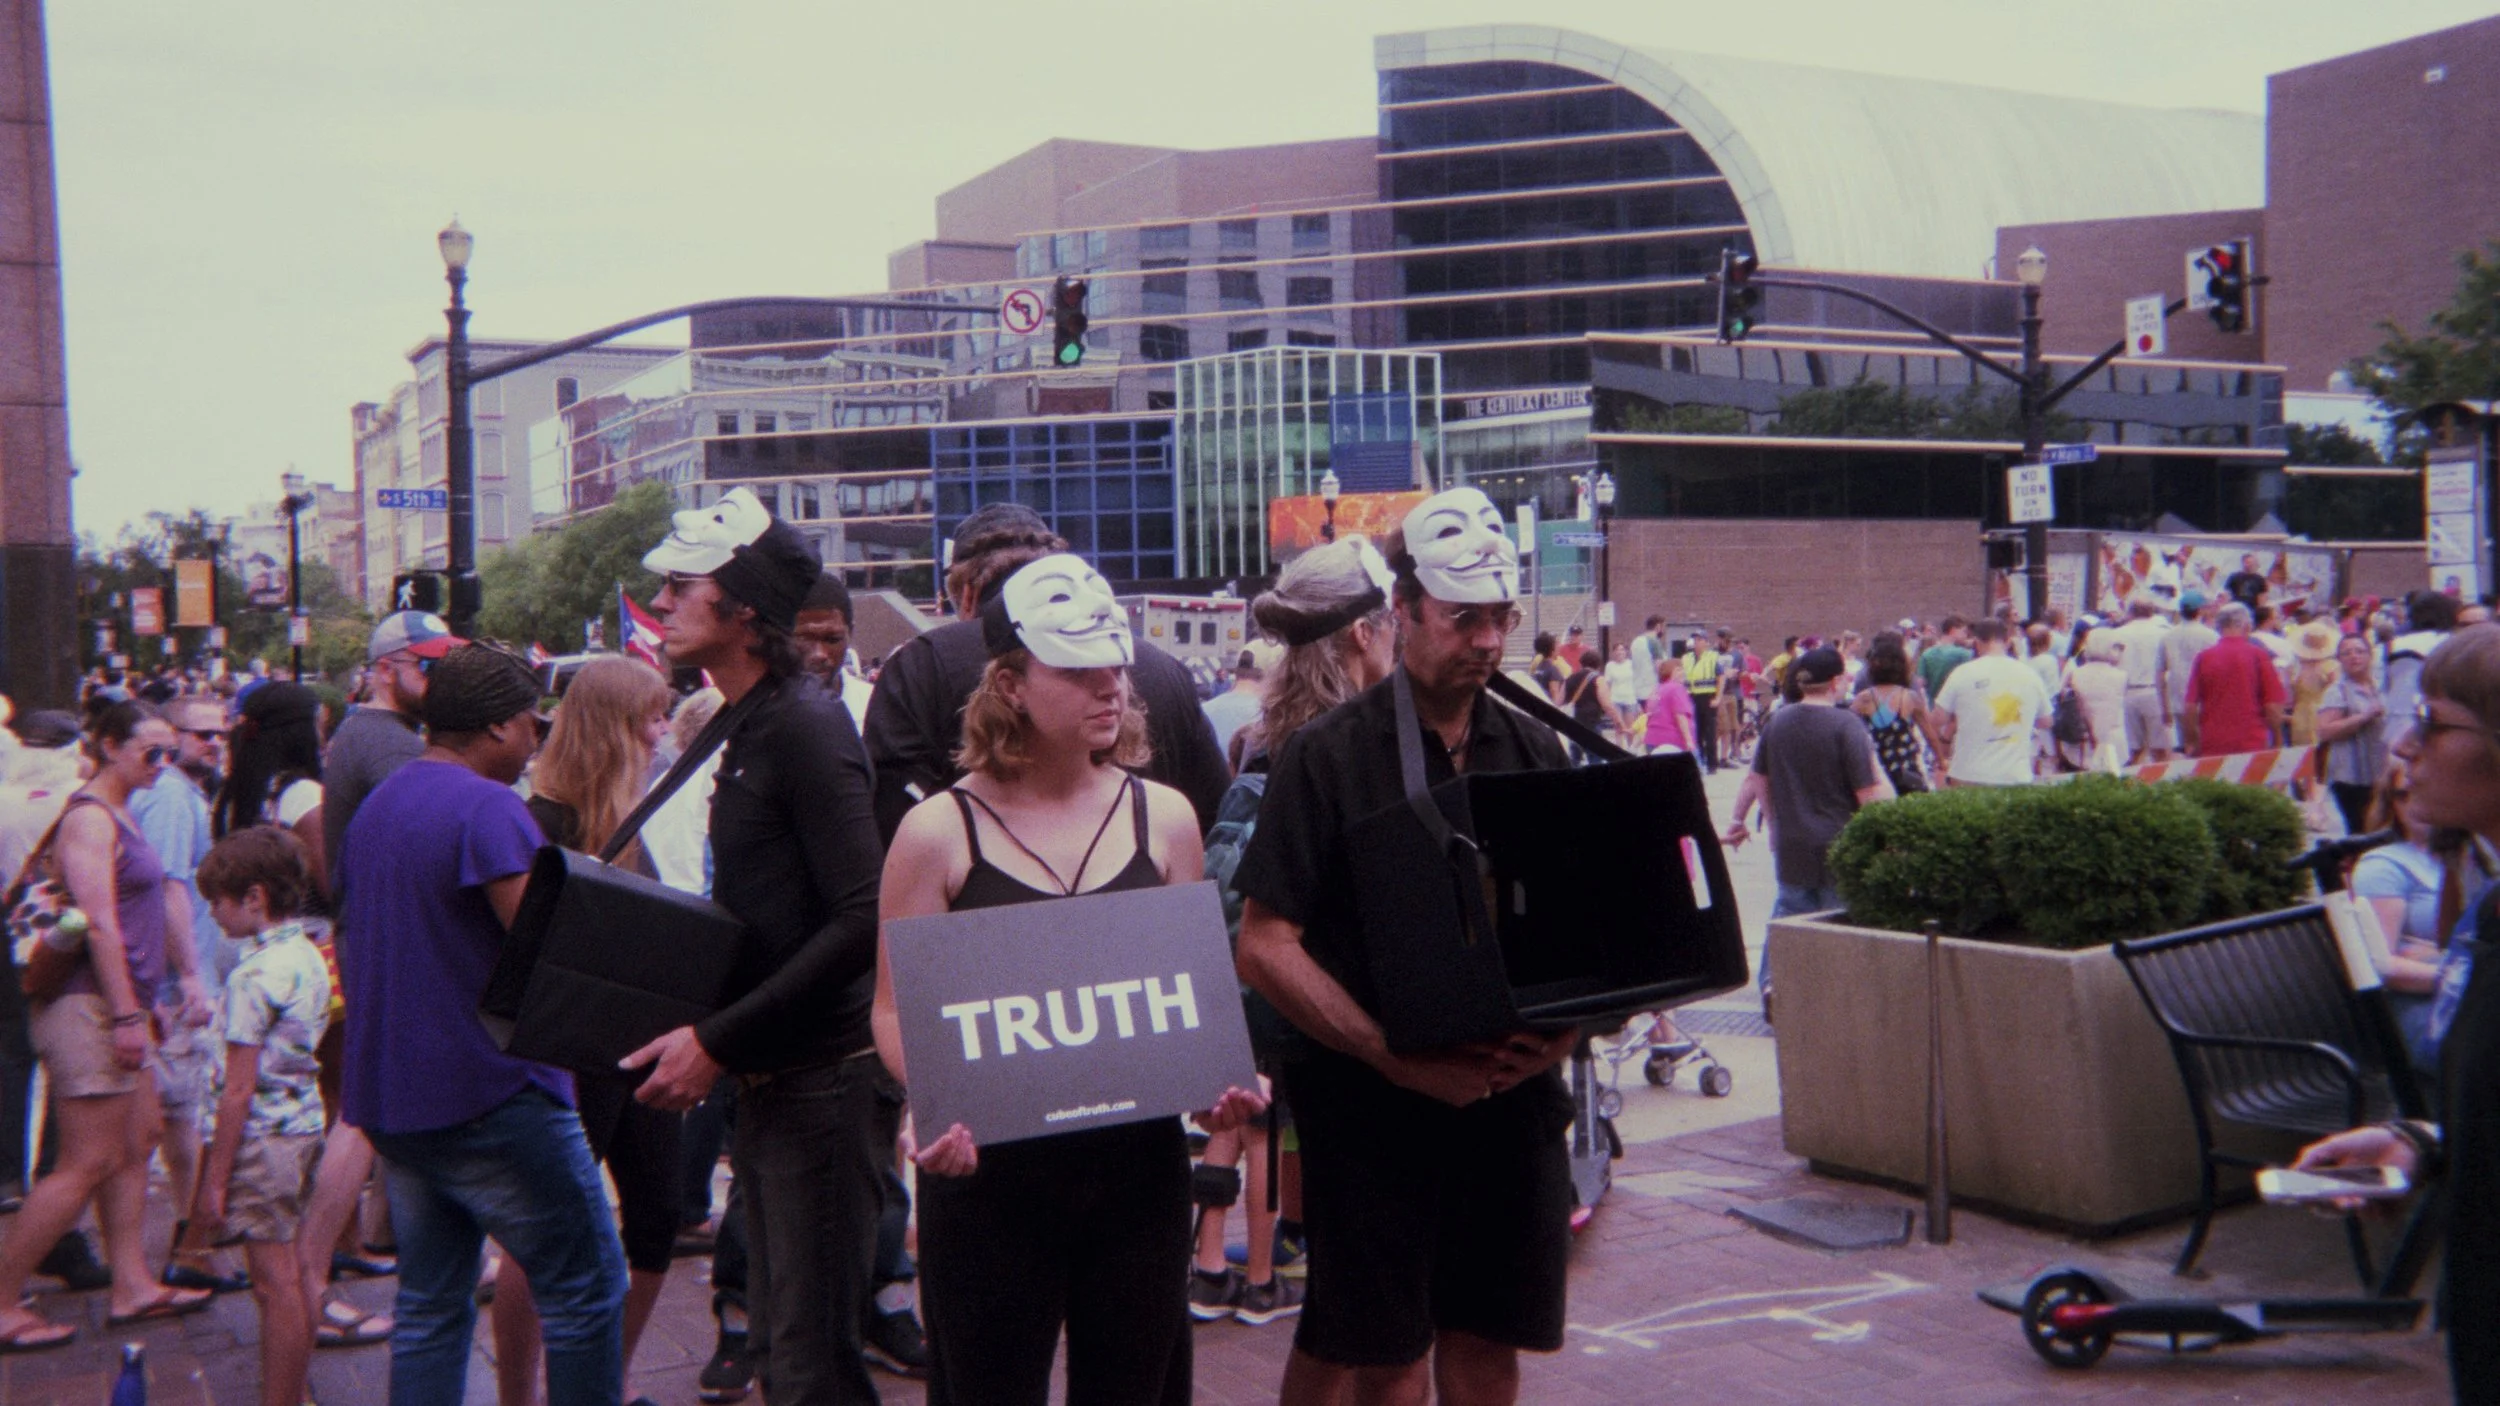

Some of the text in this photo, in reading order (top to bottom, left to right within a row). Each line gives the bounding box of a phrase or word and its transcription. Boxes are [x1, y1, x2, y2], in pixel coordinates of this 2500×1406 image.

[1464, 388, 1588, 418] THE KENTUCKY CENTER
[2058, 448, 2081, 461] Main
[2021, 471, 2037, 482] NO
[403, 490, 431, 507] 5th
[2015, 484, 2047, 497] TURN
[941, 972, 1200, 1061] TRUTH
[1046, 1100, 1136, 1121] cubeoftruth.com
